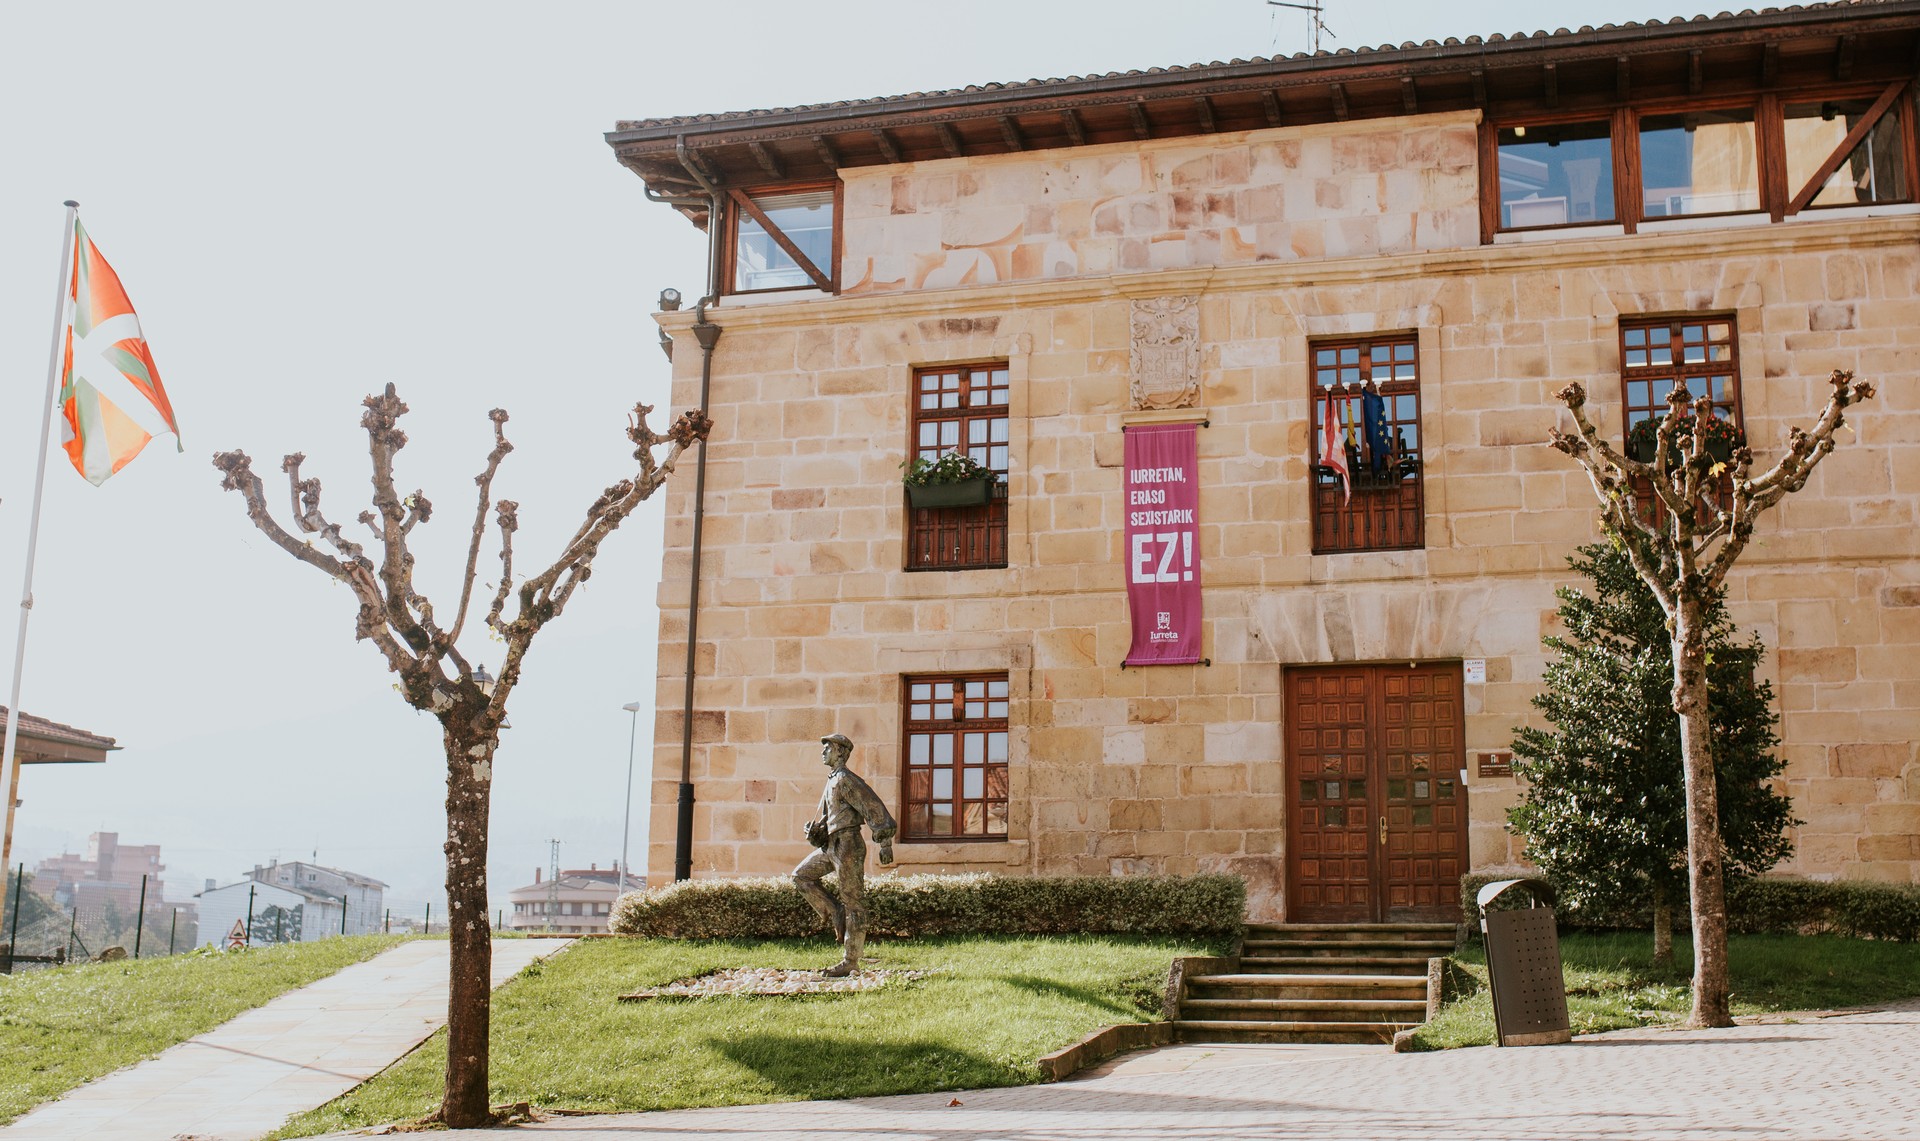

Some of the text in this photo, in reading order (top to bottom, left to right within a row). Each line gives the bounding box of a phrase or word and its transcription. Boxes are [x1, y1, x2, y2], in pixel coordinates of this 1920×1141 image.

[1130, 467, 1186, 484] IURRETAN,
[1130, 489, 1166, 505] ERASO
[1130, 509, 1193, 526] SEXISTARIK
[1132, 531, 1193, 584] EZ!
[1150, 631, 1178, 640] Iurreta
